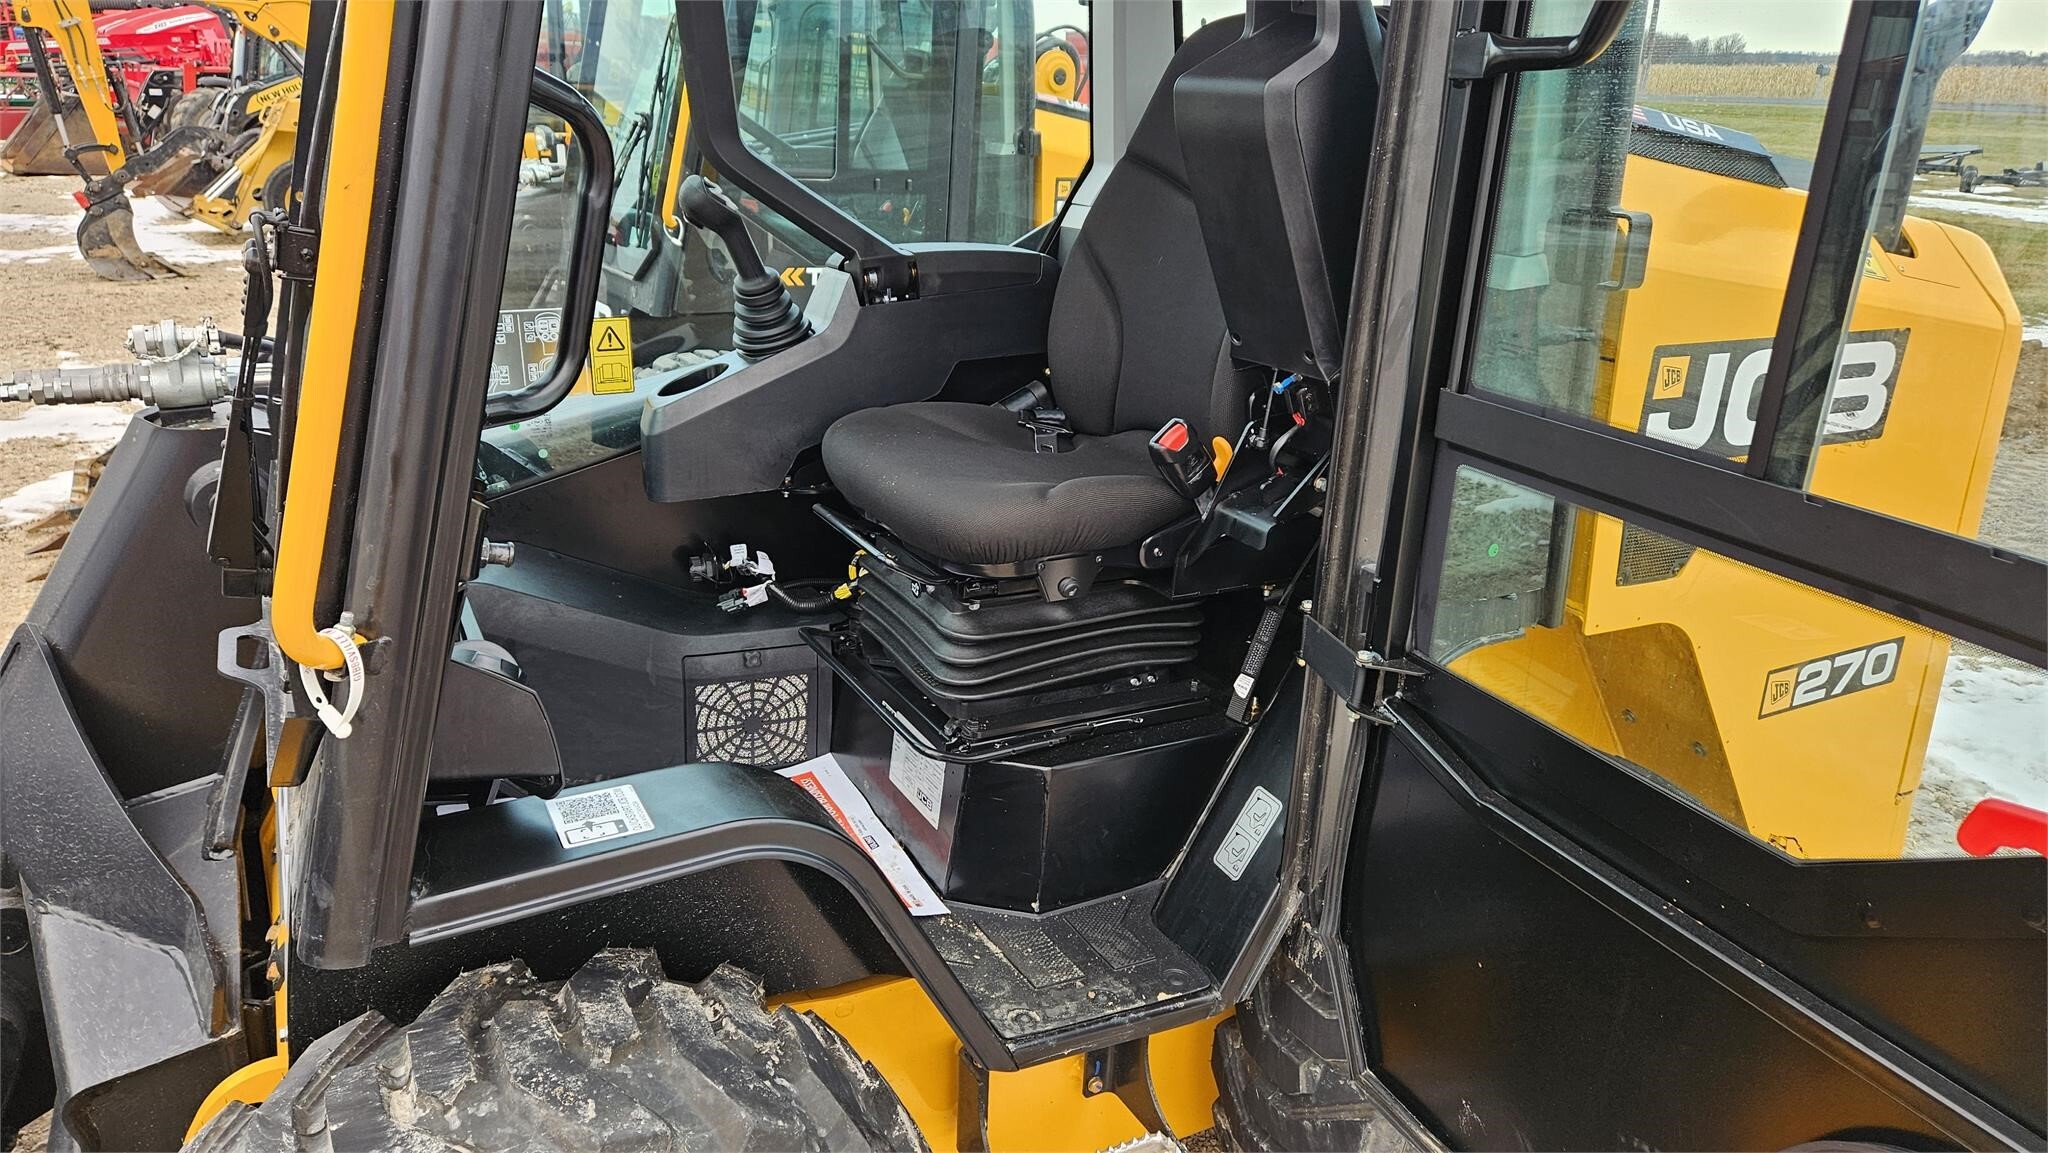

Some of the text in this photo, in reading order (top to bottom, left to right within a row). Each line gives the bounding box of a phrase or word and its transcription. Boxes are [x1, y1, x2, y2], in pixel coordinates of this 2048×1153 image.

[260, 90, 281, 102] NEW
[1661, 112, 1725, 141] USA
[1664, 367, 1682, 387] JCB
[1772, 642, 1898, 707] JCB 270
[916, 788, 933, 811] JCB
